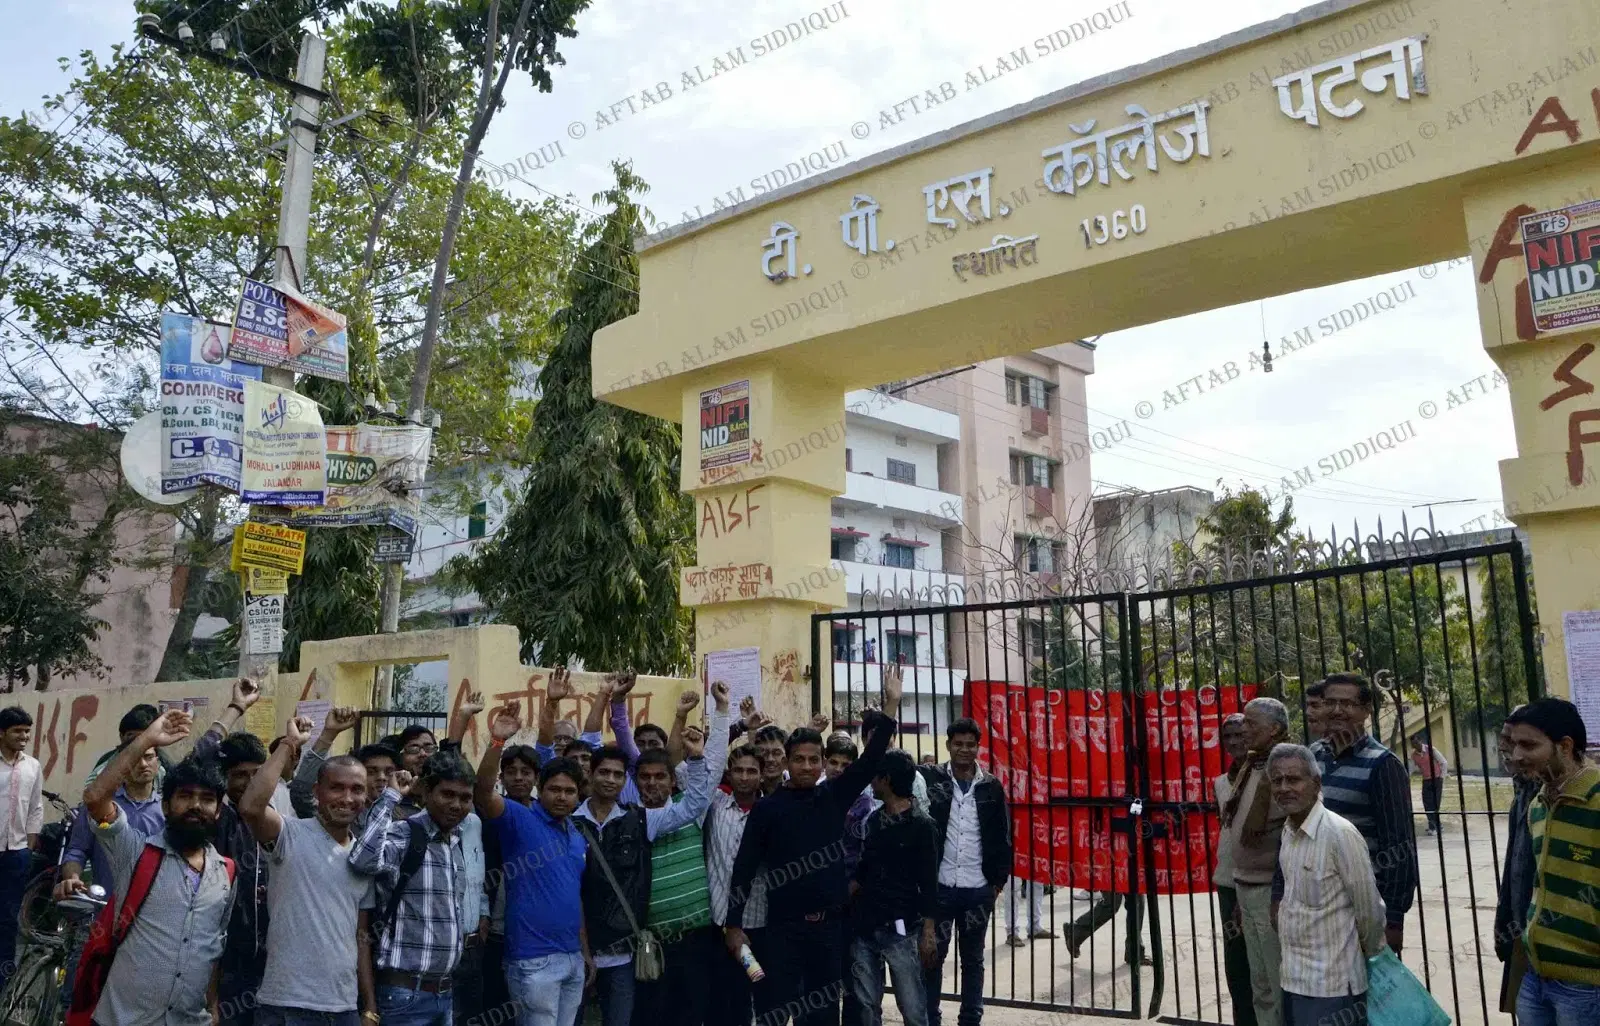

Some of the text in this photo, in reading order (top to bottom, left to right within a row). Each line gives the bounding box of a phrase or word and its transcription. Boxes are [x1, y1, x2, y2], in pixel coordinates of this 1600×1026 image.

[840, 194, 895, 255] पी.
[922, 166, 1012, 229] एस.
[1042, 103, 1211, 196] कॉलेज
[1272, 33, 1430, 127] पटना
[1079, 204, 1147, 250] 1960
[1527, 227, 1600, 271] NIF
[1532, 263, 1596, 300] NID
[162, 406, 178, 415] CA
[193, 406, 212, 415] CS
[701, 399, 748, 428] NIFT
[702, 425, 729, 449] NID
[246, 460, 274, 472] MOHALI
[281, 460, 321, 471] LUDHIANA
[327, 458, 375, 480] HYSICS
[700, 484, 765, 538] AISF
[260, 599, 280, 607] CA
